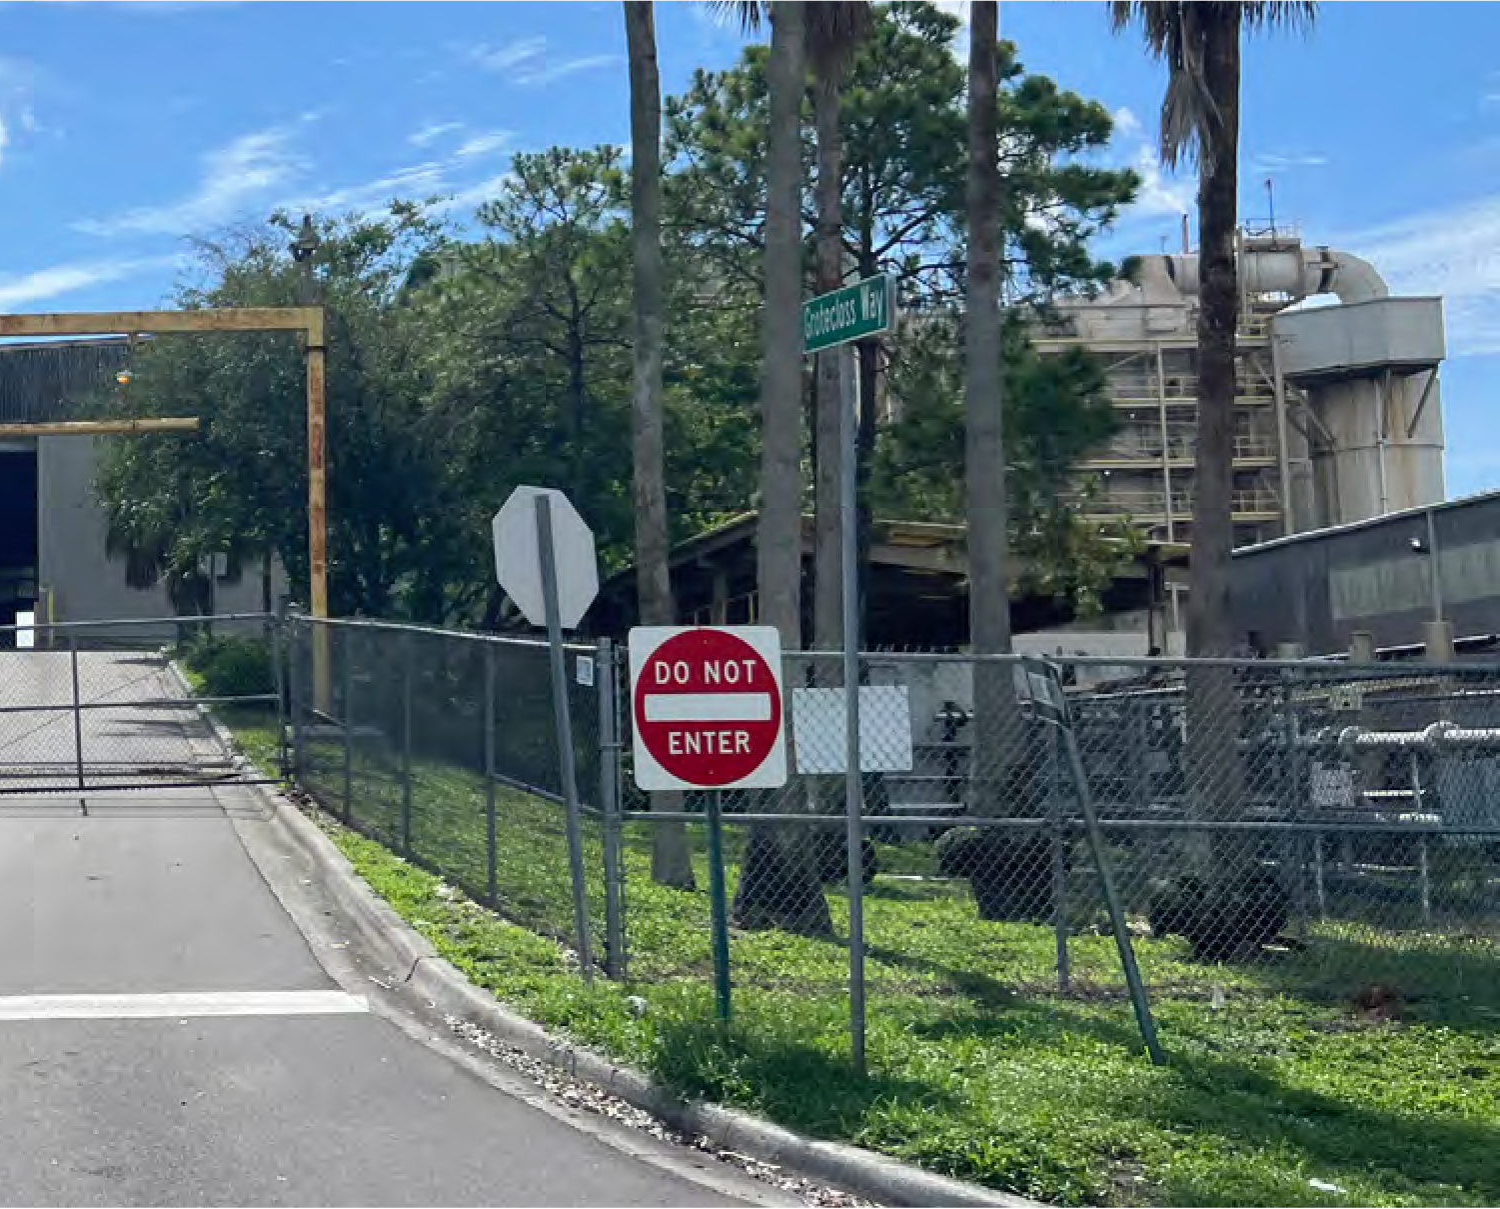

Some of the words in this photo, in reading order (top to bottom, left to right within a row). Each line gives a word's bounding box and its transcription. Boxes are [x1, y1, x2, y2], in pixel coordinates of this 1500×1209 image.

[861, 284, 884, 327] Way
[654, 660, 690, 685] DO
[703, 659, 757, 684] NOT
[668, 730, 751, 755] ENTER
